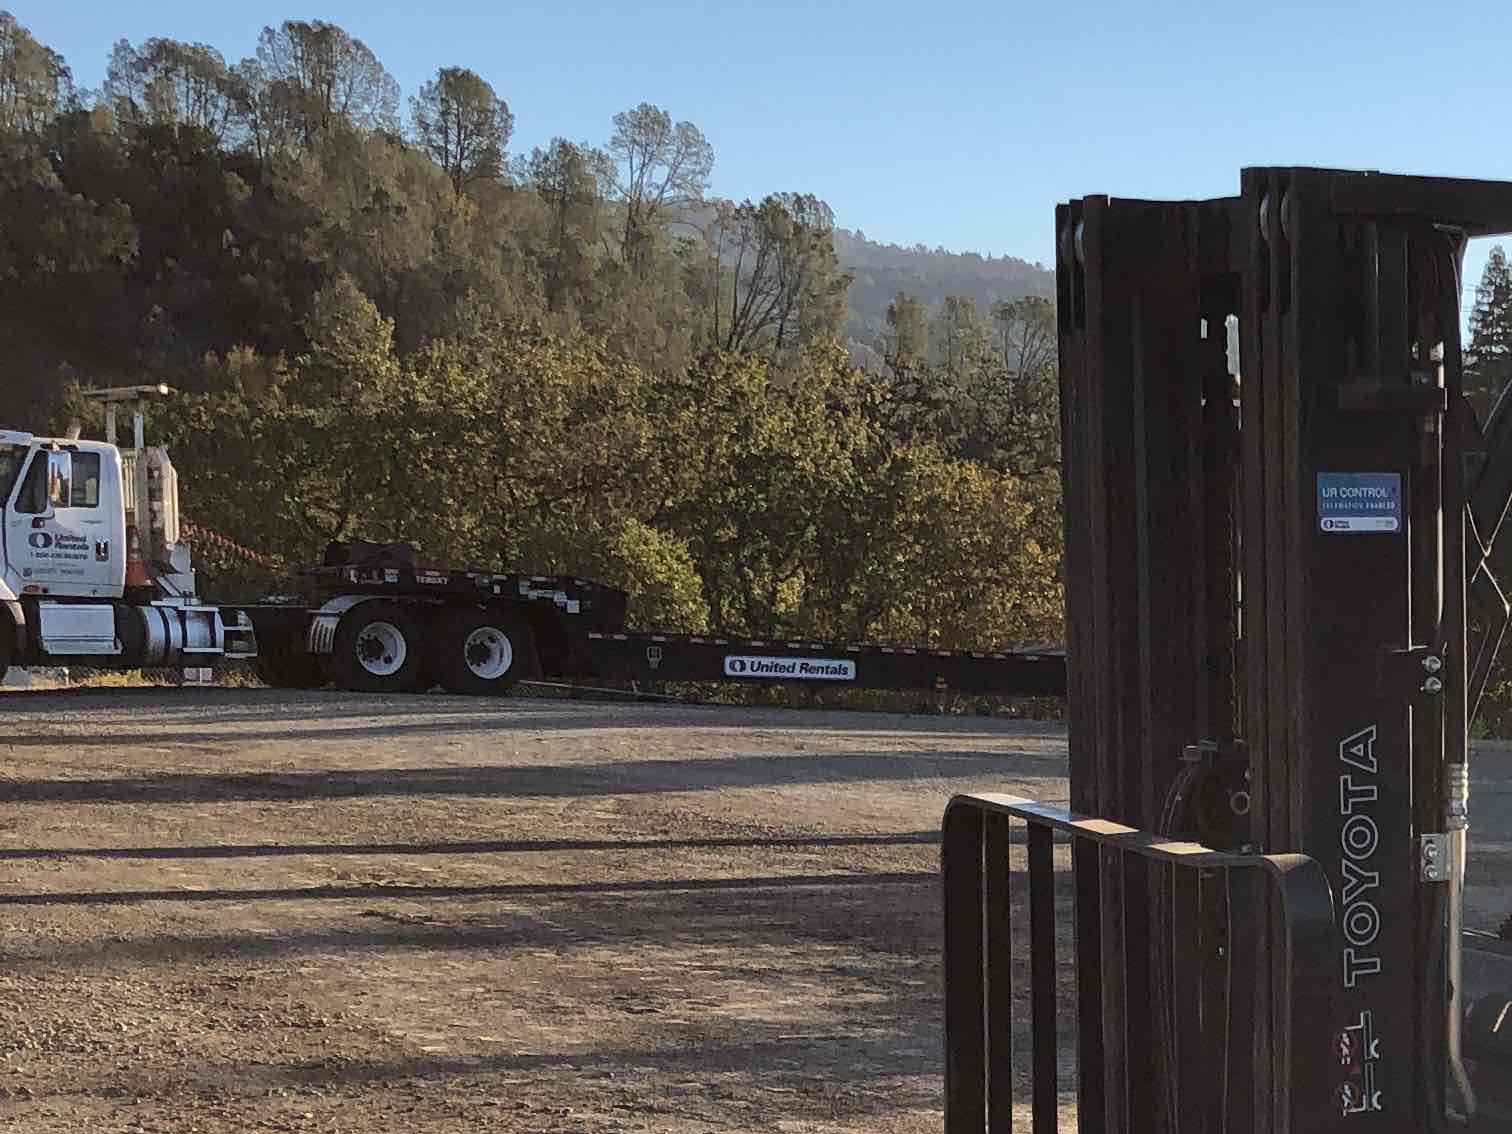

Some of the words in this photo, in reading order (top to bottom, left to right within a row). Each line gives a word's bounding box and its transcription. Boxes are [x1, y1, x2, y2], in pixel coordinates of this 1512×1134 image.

[1322, 487, 1337, 498] UR
[1340, 487, 1390, 498] CONTROL
[750, 660, 797, 674] United
[800, 662, 849, 676] Rentals
[1339, 724, 1382, 988] TOYOTA
